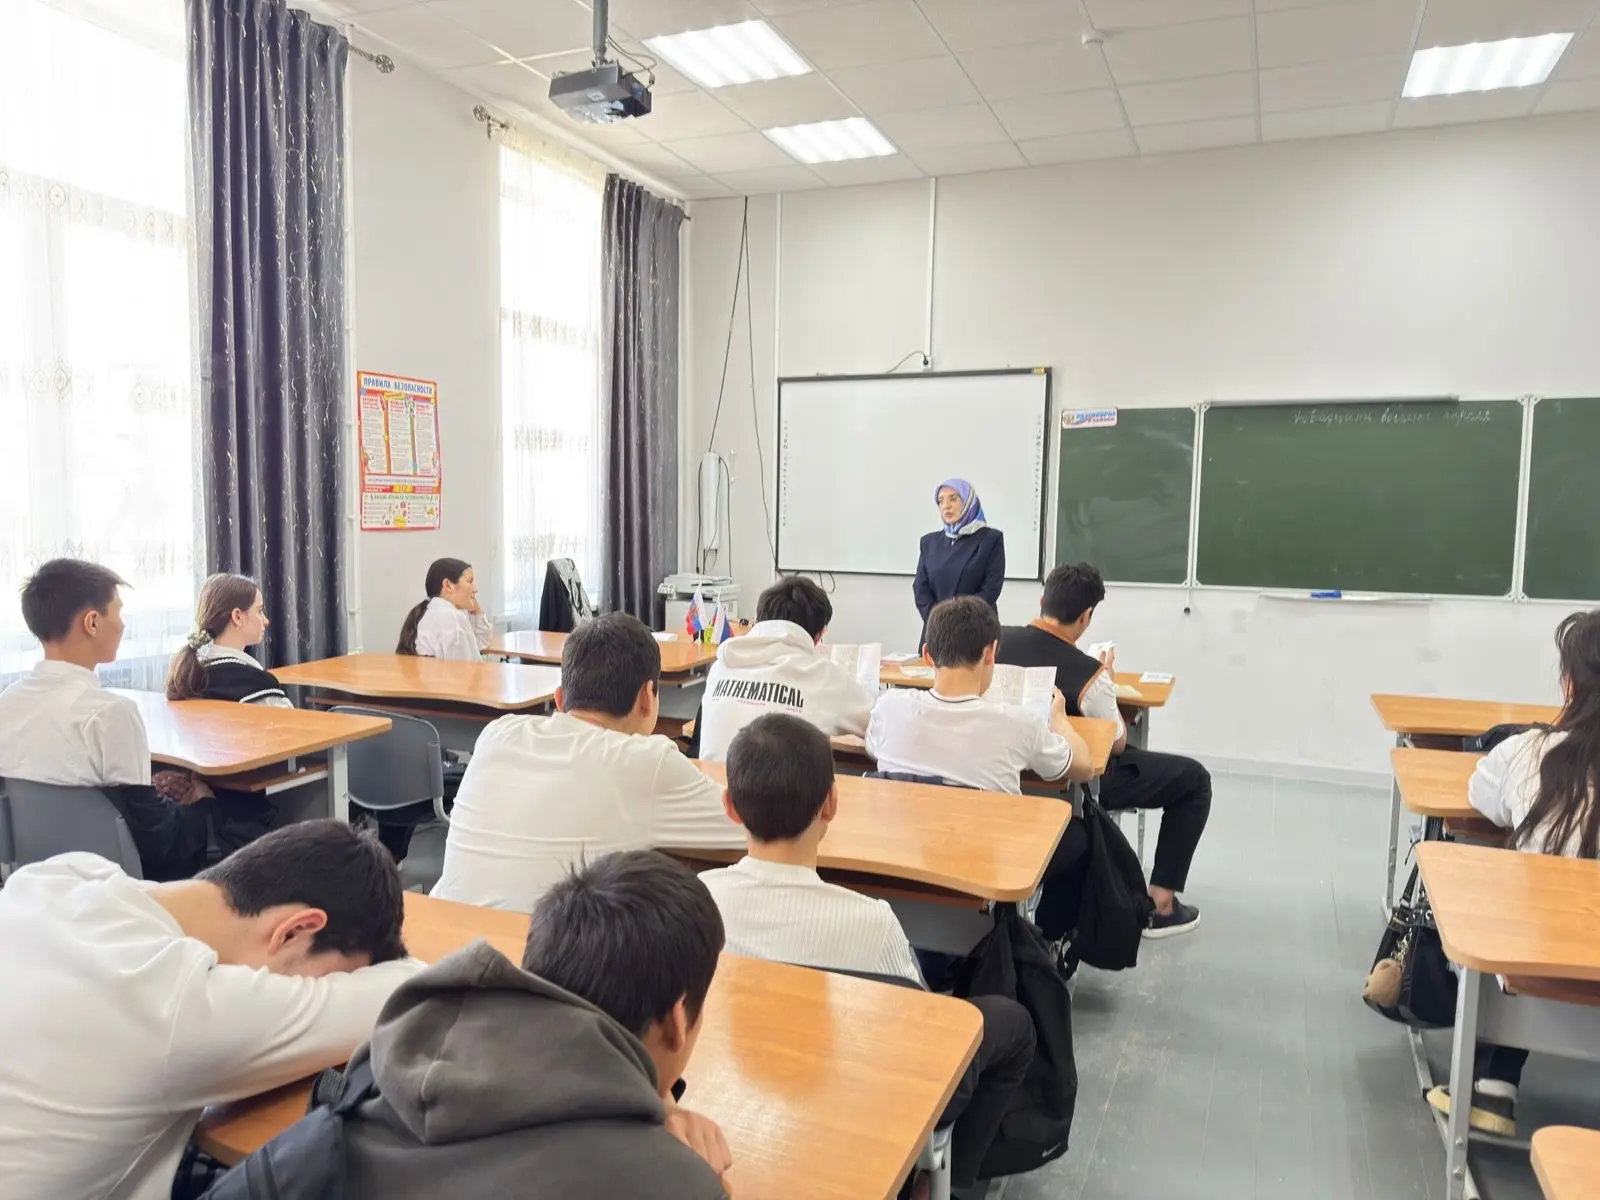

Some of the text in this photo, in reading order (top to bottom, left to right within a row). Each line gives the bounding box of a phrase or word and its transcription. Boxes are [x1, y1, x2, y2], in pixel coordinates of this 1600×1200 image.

[363, 377, 433, 395] ПРАВИЛА БЕЗОПАСНОСТИ
[712, 679, 804, 708] MATHEMATICAL
